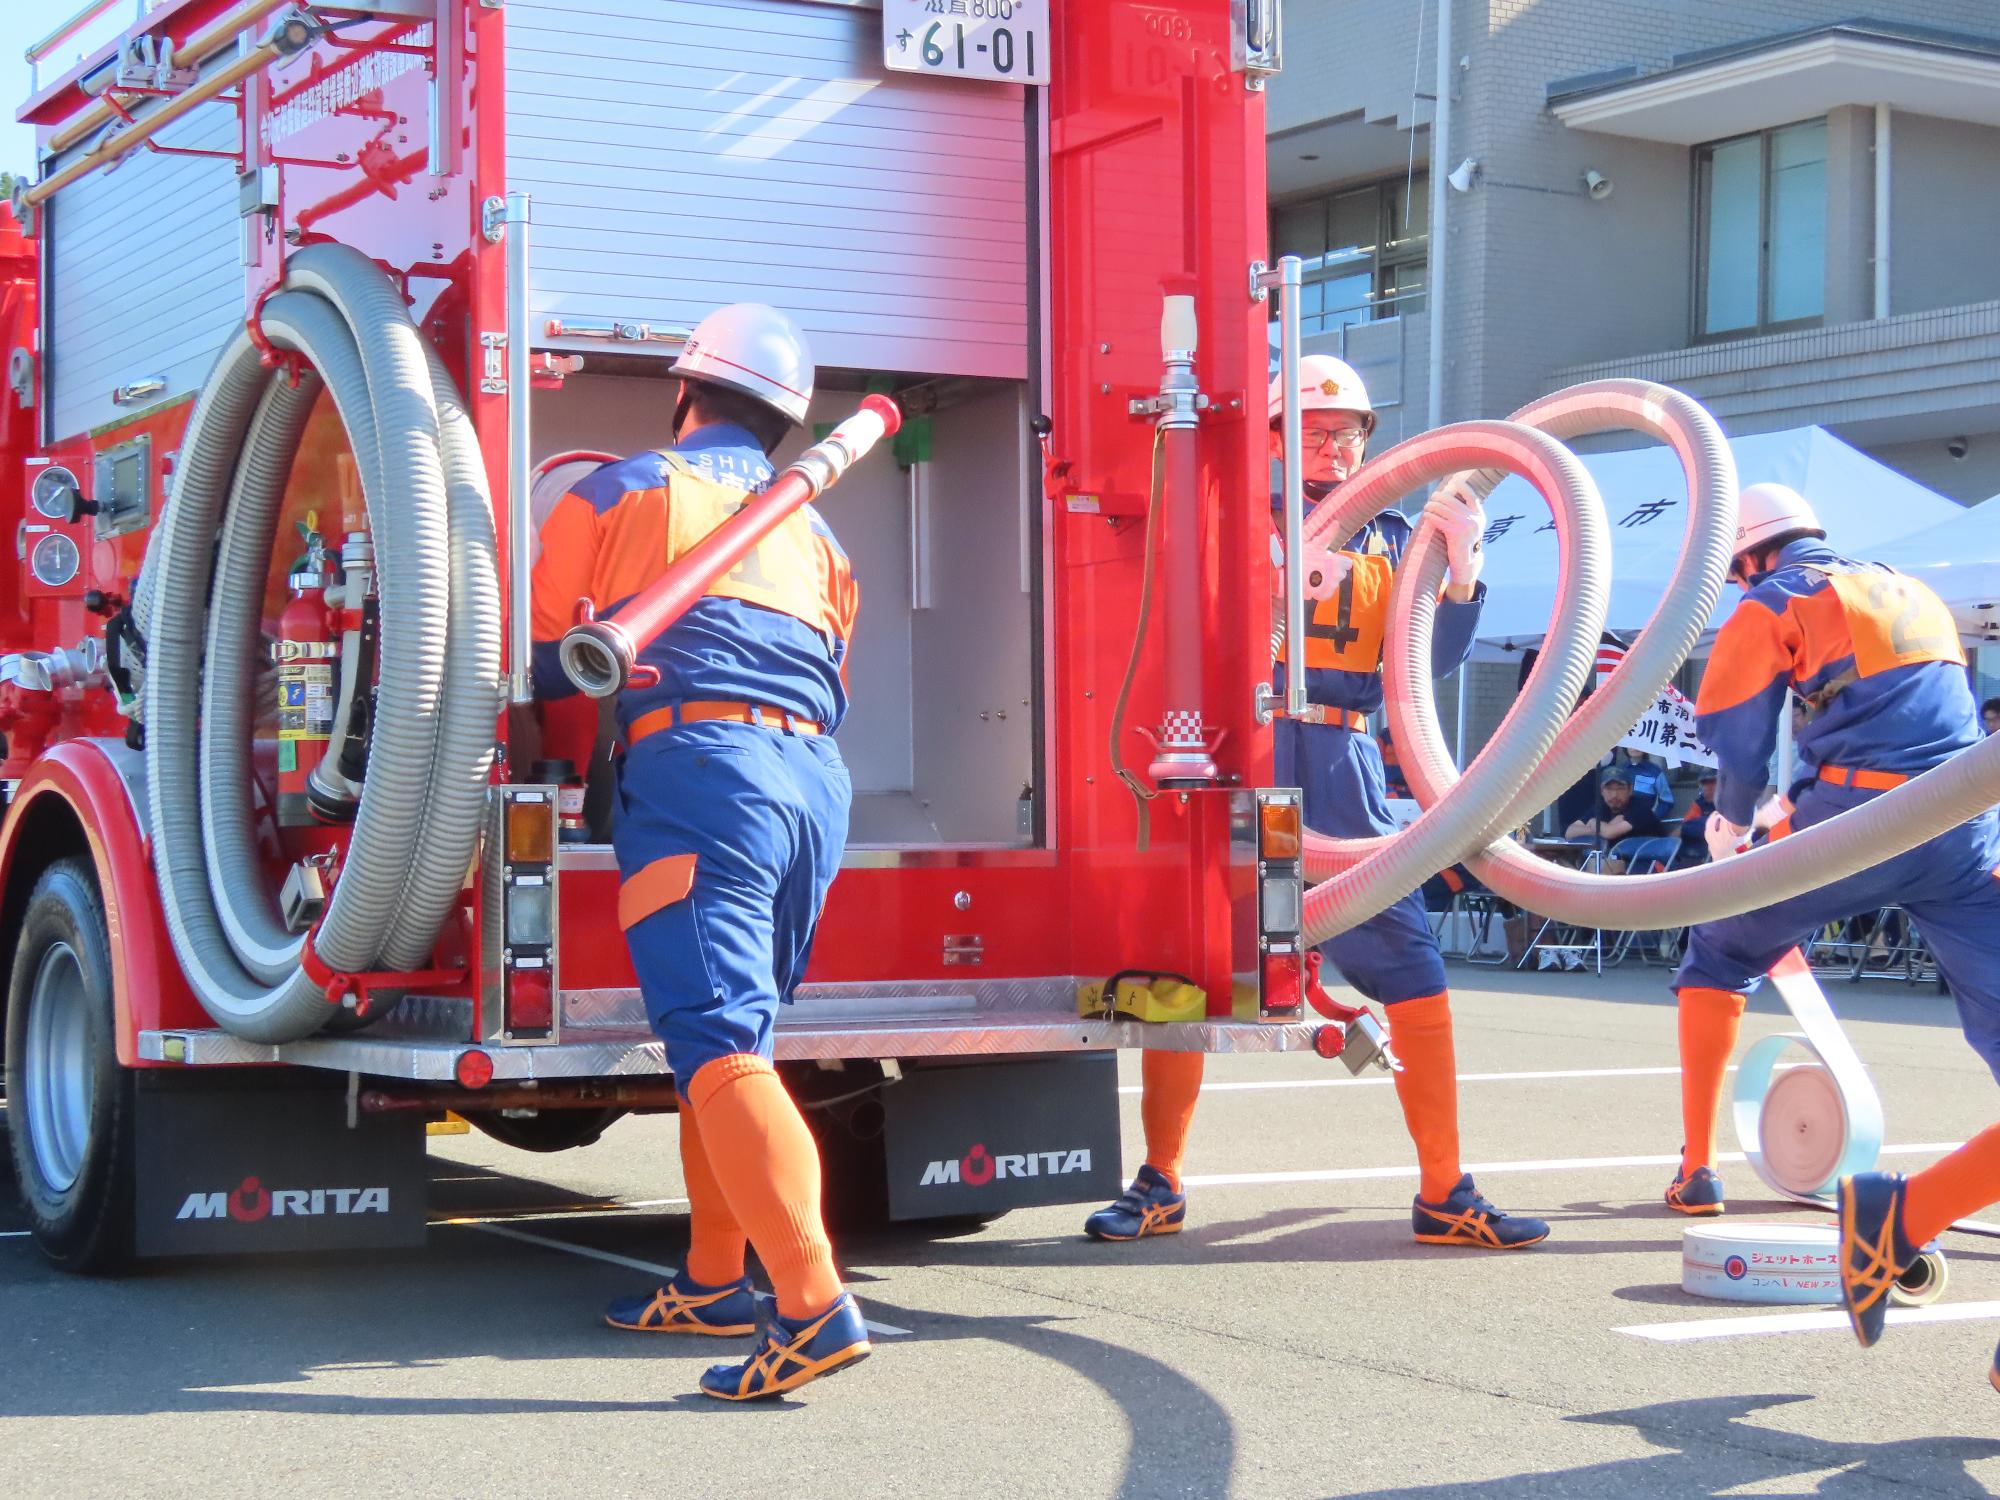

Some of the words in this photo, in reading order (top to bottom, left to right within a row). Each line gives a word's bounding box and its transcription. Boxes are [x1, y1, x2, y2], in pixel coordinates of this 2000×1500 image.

[896, 28, 913, 51] す
[923, 21, 1034, 76] 61-01
[1482, 498, 1678, 545] 高市
[1303, 566, 1359, 654] 4
[1868, 582, 1943, 654] 2
[919, 1143, 1091, 1186] MORITA
[176, 1175, 389, 1223] MORITA
[1751, 1251, 1838, 1265] ジェットホース
